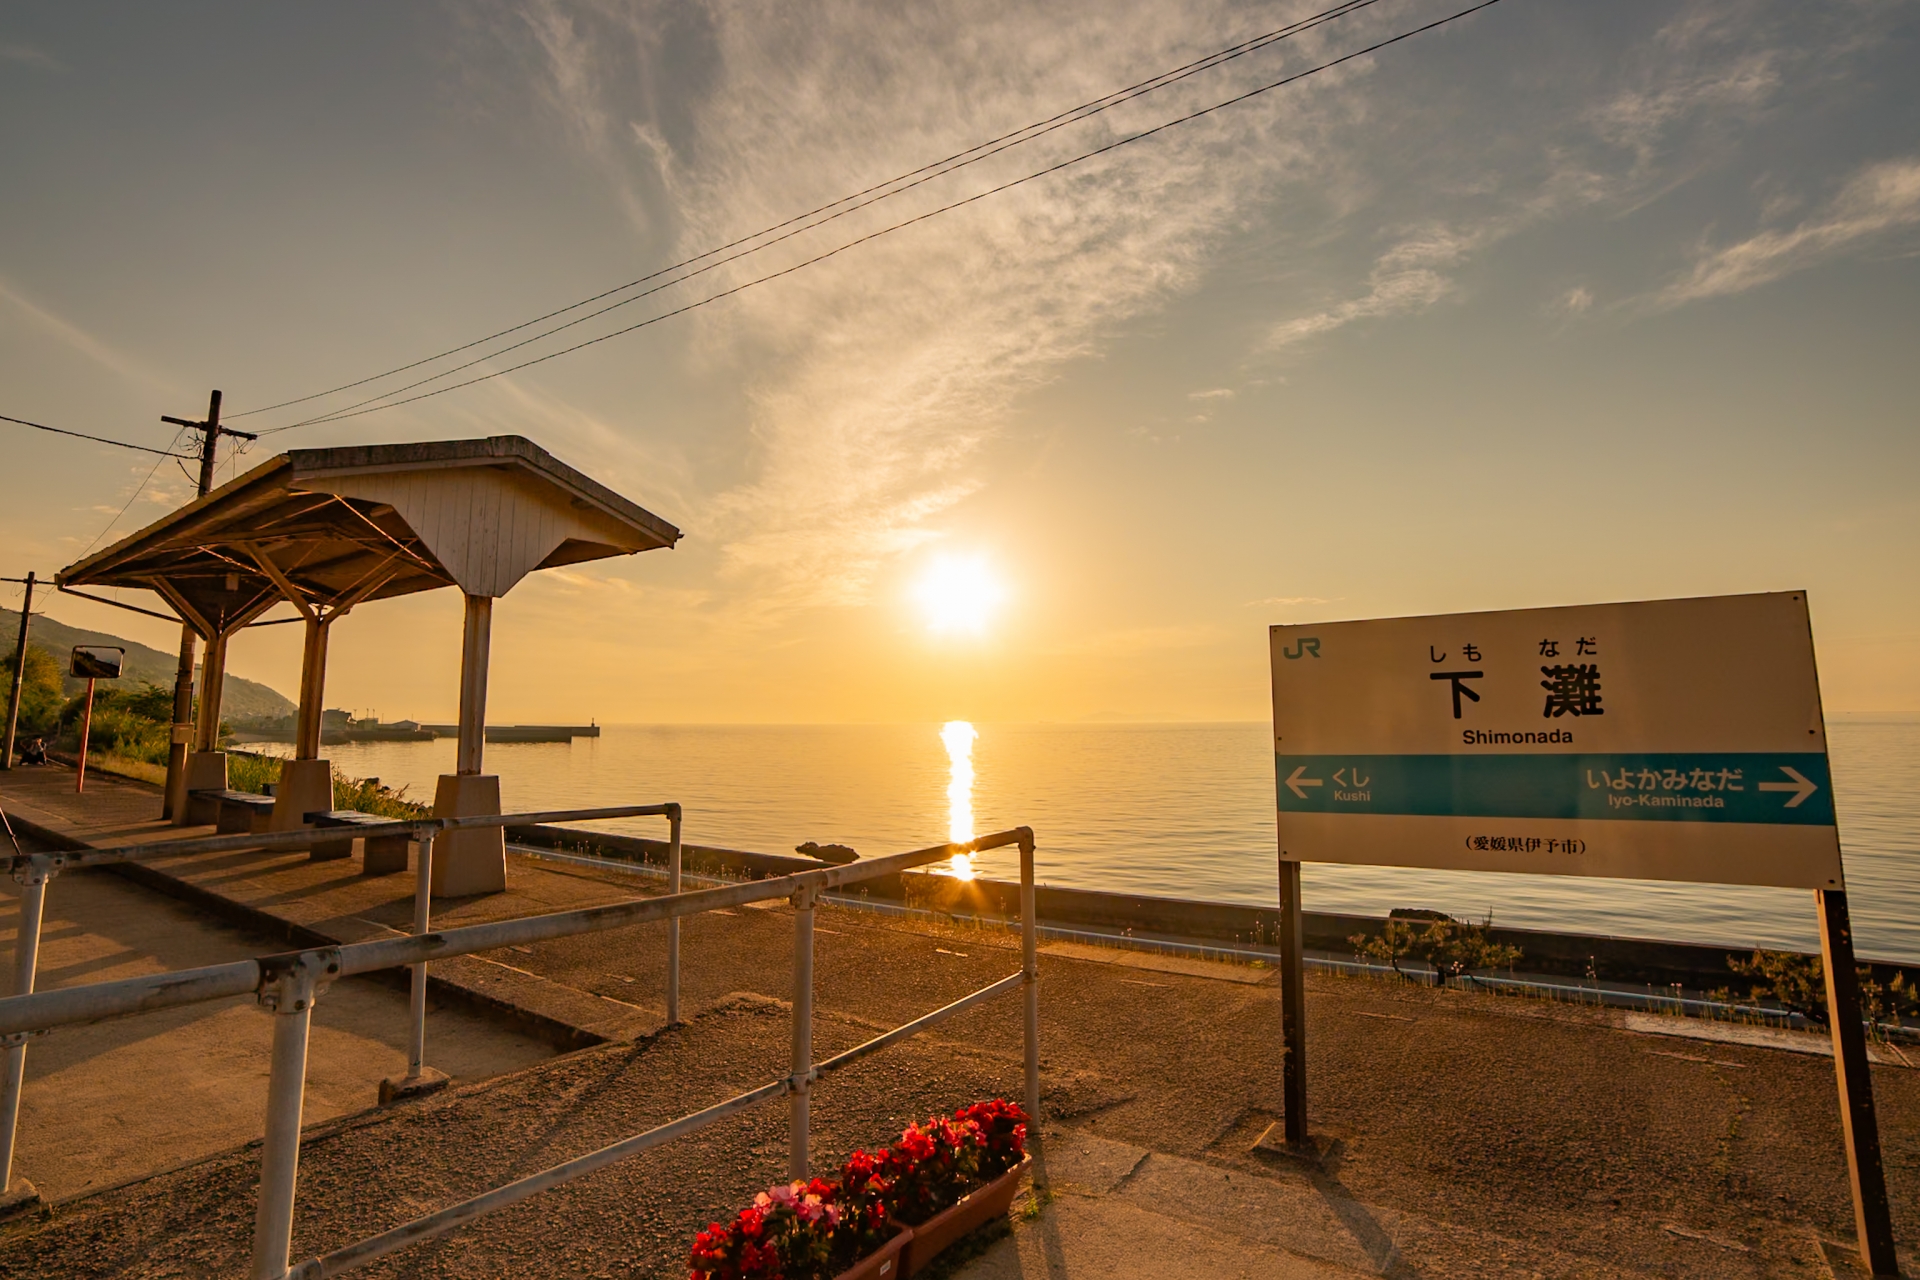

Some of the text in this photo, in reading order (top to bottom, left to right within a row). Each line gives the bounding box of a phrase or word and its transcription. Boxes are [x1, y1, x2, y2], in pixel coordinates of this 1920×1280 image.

[1283, 637, 1321, 660] JR
[1462, 728, 1573, 745] Shimonada
[1332, 767, 1370, 788] くし
[1586, 768, 1744, 792] いよかみなだ
[1334, 790, 1371, 802] Kushi
[1608, 794, 1725, 810] Iyo-Kaminada
